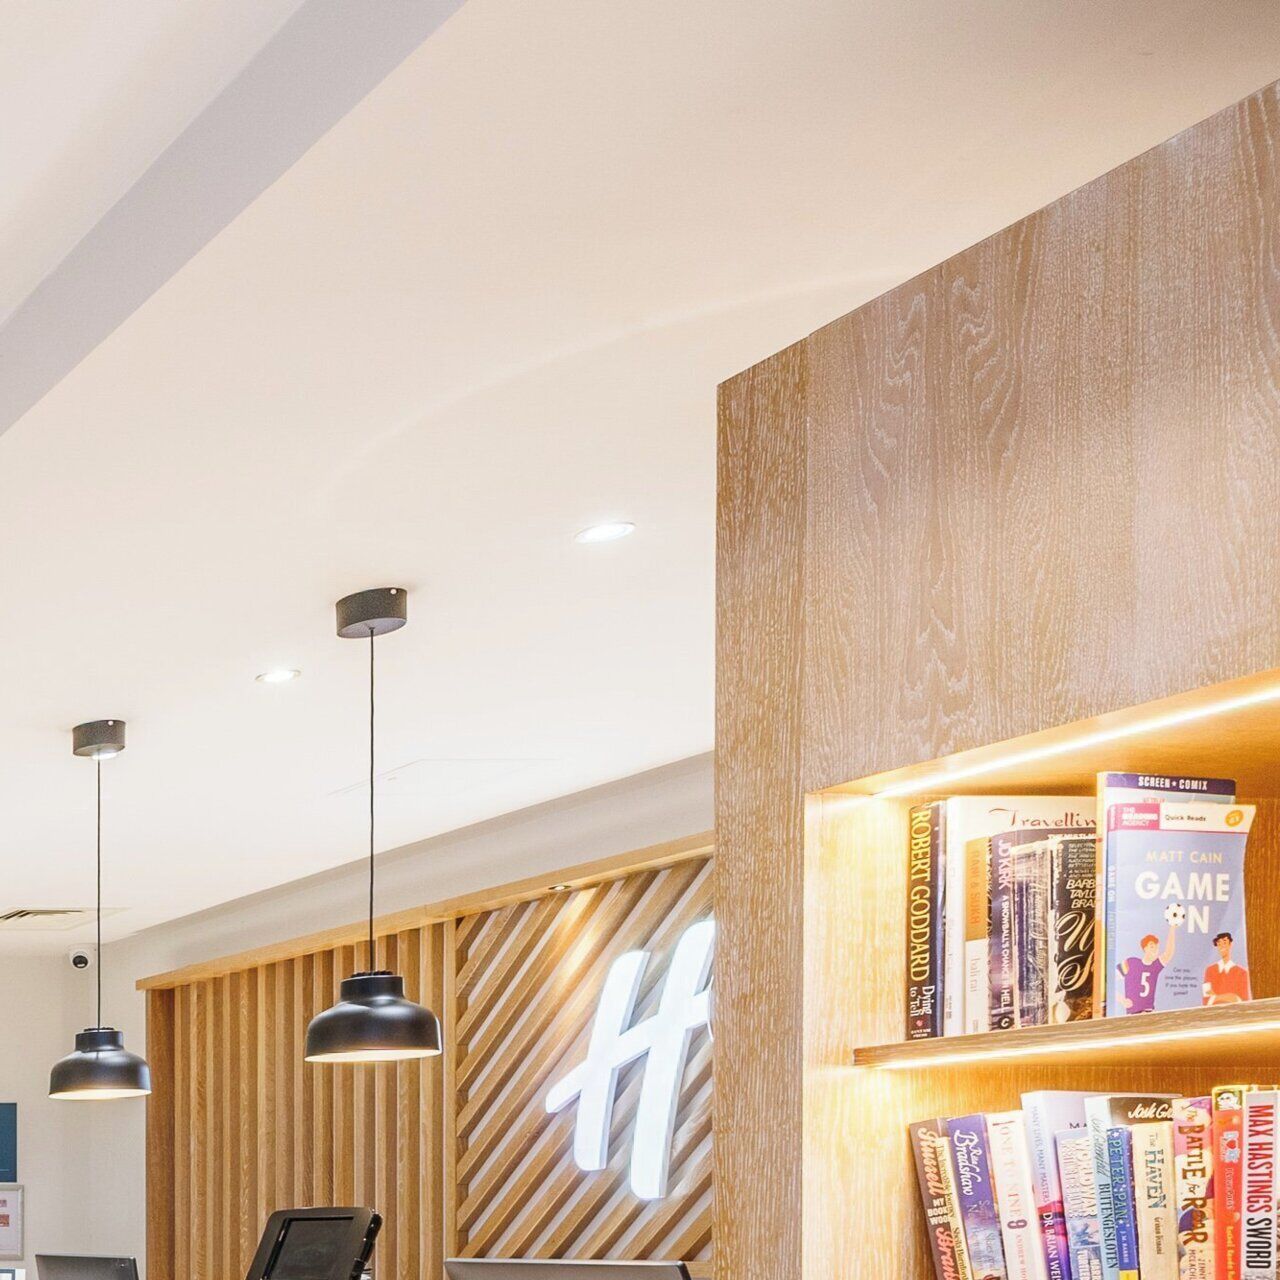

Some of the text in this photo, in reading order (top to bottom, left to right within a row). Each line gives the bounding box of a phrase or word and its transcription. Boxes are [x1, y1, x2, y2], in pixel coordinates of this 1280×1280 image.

[1138, 776, 1208, 791] SCREEN COMIX
[1146, 851, 1223, 864] MATT CAIN
[998, 858, 1011, 890] KIRK
[1134, 870, 1230, 902] GAME
[910, 808, 932, 981] ROBERT GODDARD
[922, 985, 936, 1015] Dying
[1139, 972, 1151, 998] 5
[910, 986, 921, 1017] to Tell
[1128, 1103, 1155, 1119] Josh
[954, 1130, 981, 1196] Bradshaw
[969, 1132, 983, 1165] Rita
[1178, 1124, 1206, 1180] BATTLE
[1108, 1139, 1129, 1221] PETER PAN
[1187, 1182, 1200, 1195] for
[1246, 1104, 1274, 1269] MAX HASTINGS SWORD
[933, 1198, 944, 1207] MY
[1043, 1212, 1054, 1227] DR
[1097, 1183, 1119, 1269] BUITENGESLOTEN
[1045, 1228, 1059, 1259] BRIAN
